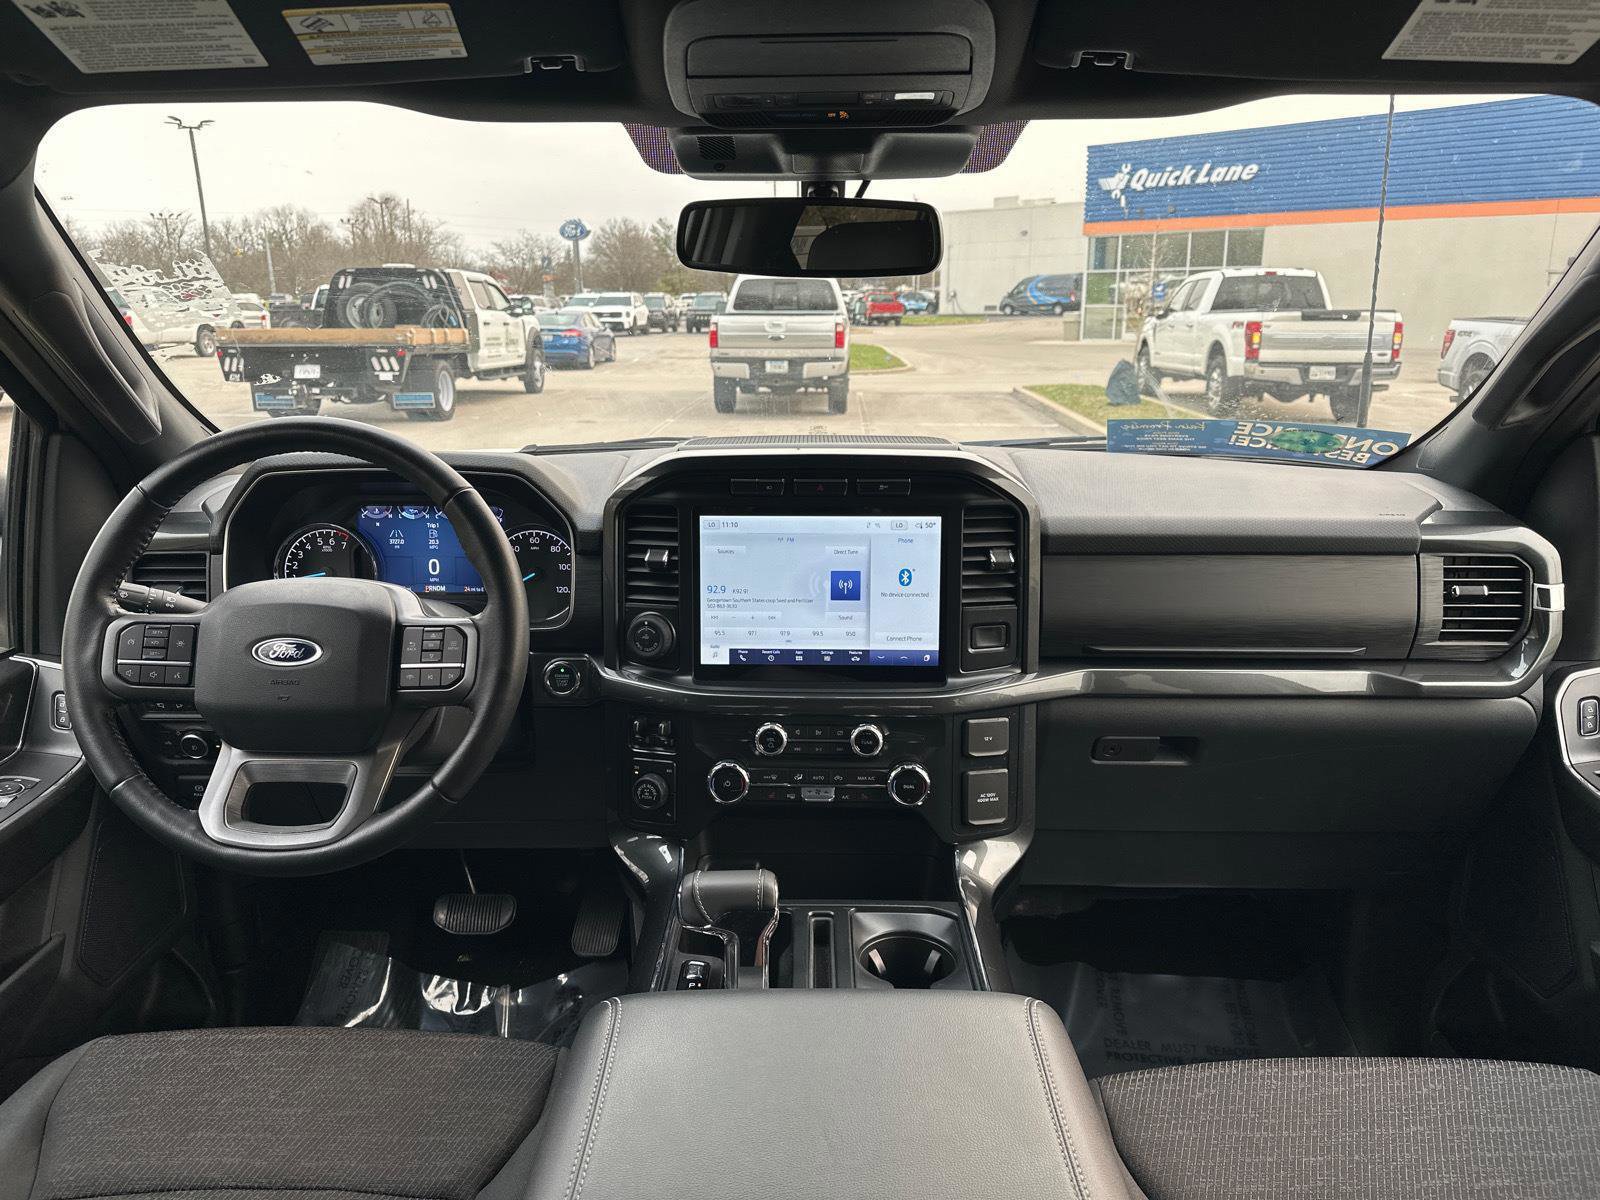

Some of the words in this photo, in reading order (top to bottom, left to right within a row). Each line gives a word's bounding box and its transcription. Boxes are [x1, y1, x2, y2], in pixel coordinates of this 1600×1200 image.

[1130, 165, 1196, 191] Quick
[1196, 163, 1260, 185] Lane
[305, 542, 311, 550] 4
[341, 542, 347, 550] 7
[297, 550, 303, 558] 3
[428, 558, 440, 575] 0
[707, 585, 727, 594] 92.9
[269, 642, 305, 659] Ford
